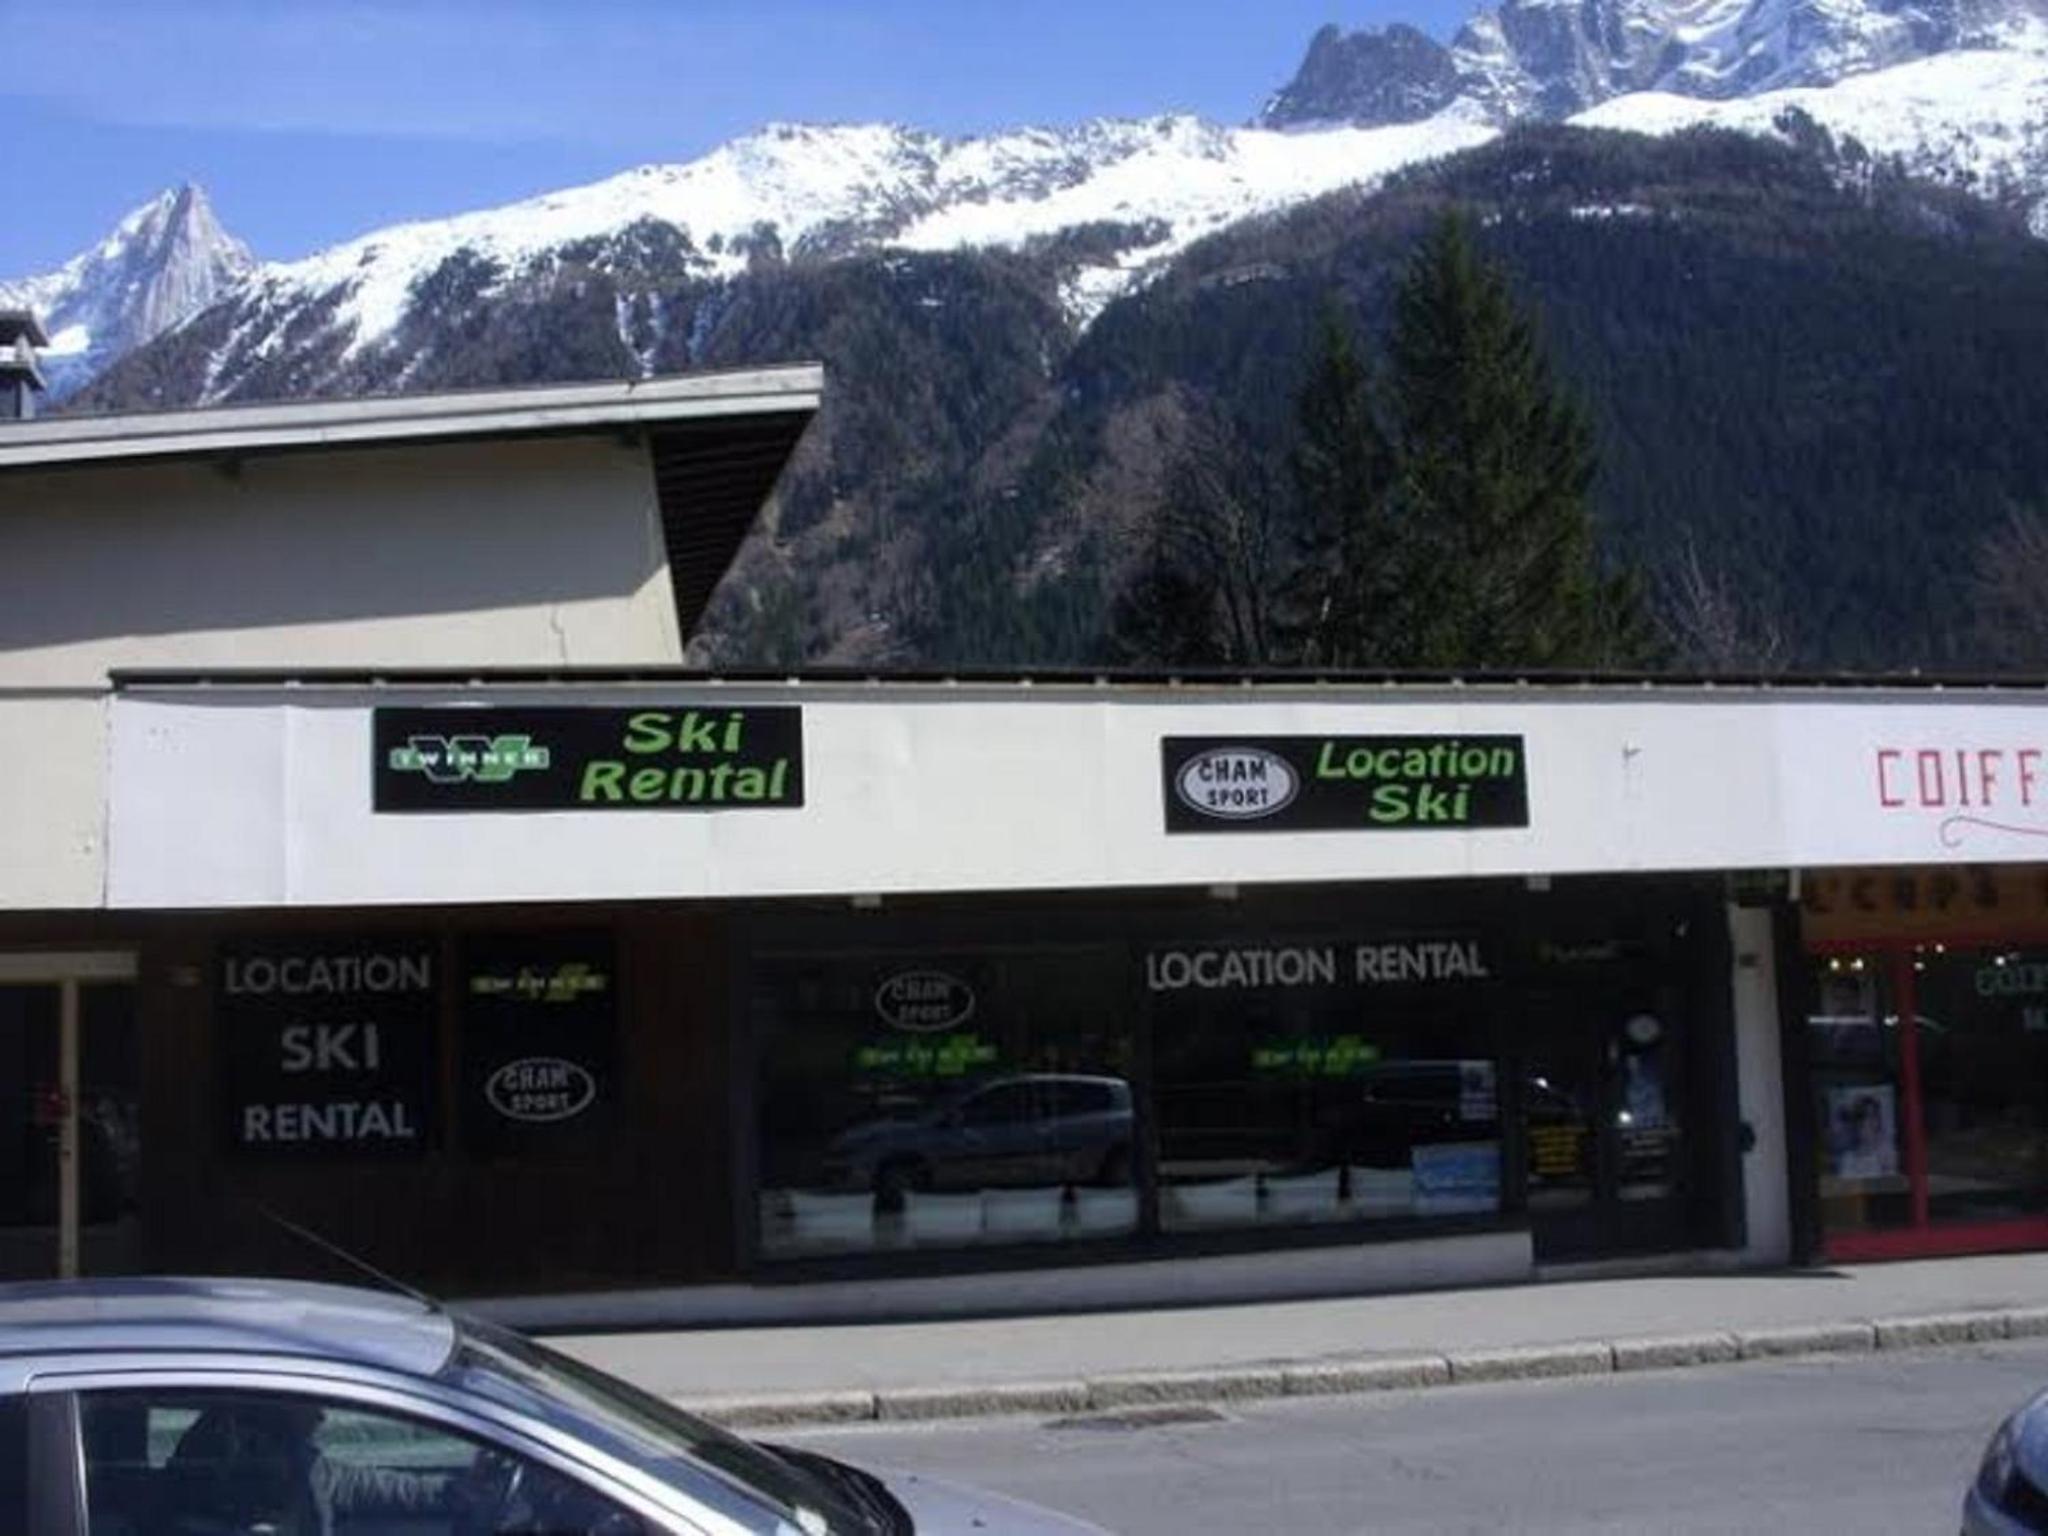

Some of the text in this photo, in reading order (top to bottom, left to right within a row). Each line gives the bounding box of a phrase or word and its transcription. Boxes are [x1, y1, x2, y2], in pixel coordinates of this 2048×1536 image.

[623, 713, 744, 753] Ski
[1199, 758, 1266, 783] CHAM
[1316, 741, 1515, 778] Location
[578, 759, 788, 801] Rental
[1207, 787, 1268, 807] SPORT
[1368, 783, 1471, 822] Ski
[225, 955, 430, 993] LOCATION
[1147, 941, 1488, 990] LOCATION RENTAL
[281, 1021, 380, 1071] SKI
[503, 1065, 569, 1092] CHAM
[244, 1103, 413, 1142] RENTAL
